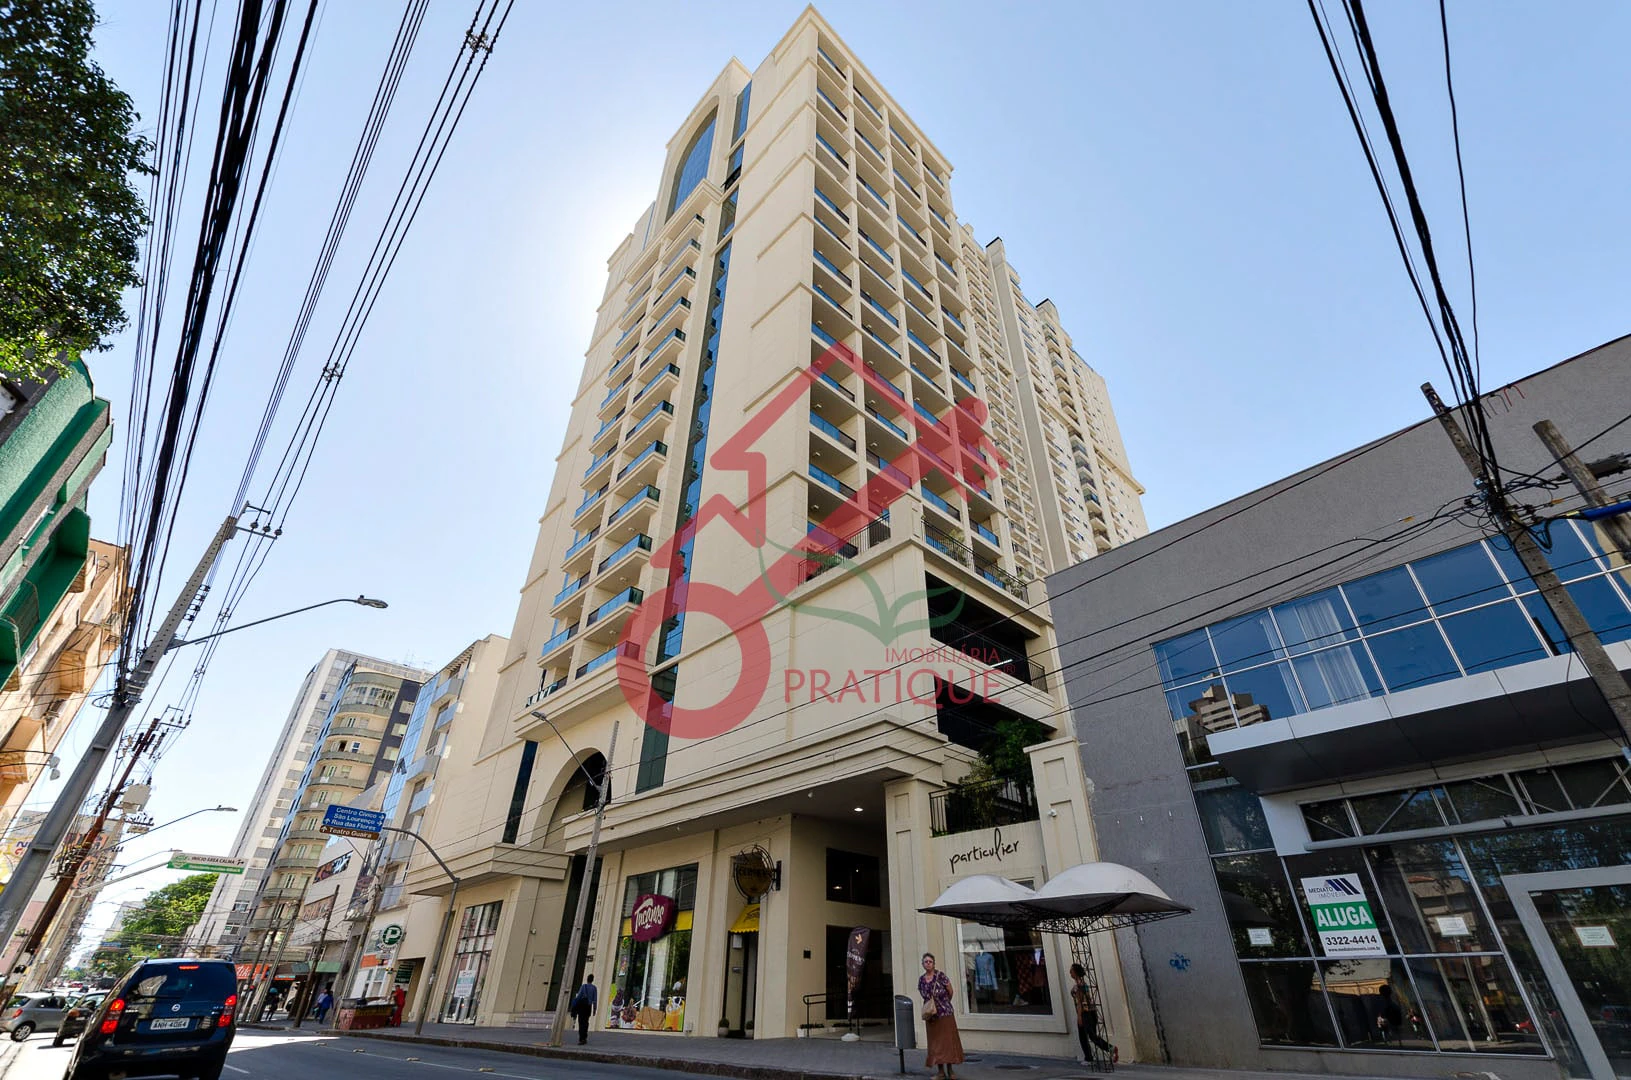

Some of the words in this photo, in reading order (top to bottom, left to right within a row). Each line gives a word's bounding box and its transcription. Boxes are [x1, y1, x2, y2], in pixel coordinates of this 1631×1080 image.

[336, 807, 359, 816] Centro
[331, 819, 343, 827] Rua
[357, 822, 376, 831] Flores
[333, 813, 346, 821] São
[347, 815, 375, 825] Lourenço
[328, 827, 350, 836] Teatro
[949, 828, 1019, 874] particulier
[1316, 906, 1373, 927] ALUGA
[1325, 935, 1377, 946] 3322-4414
